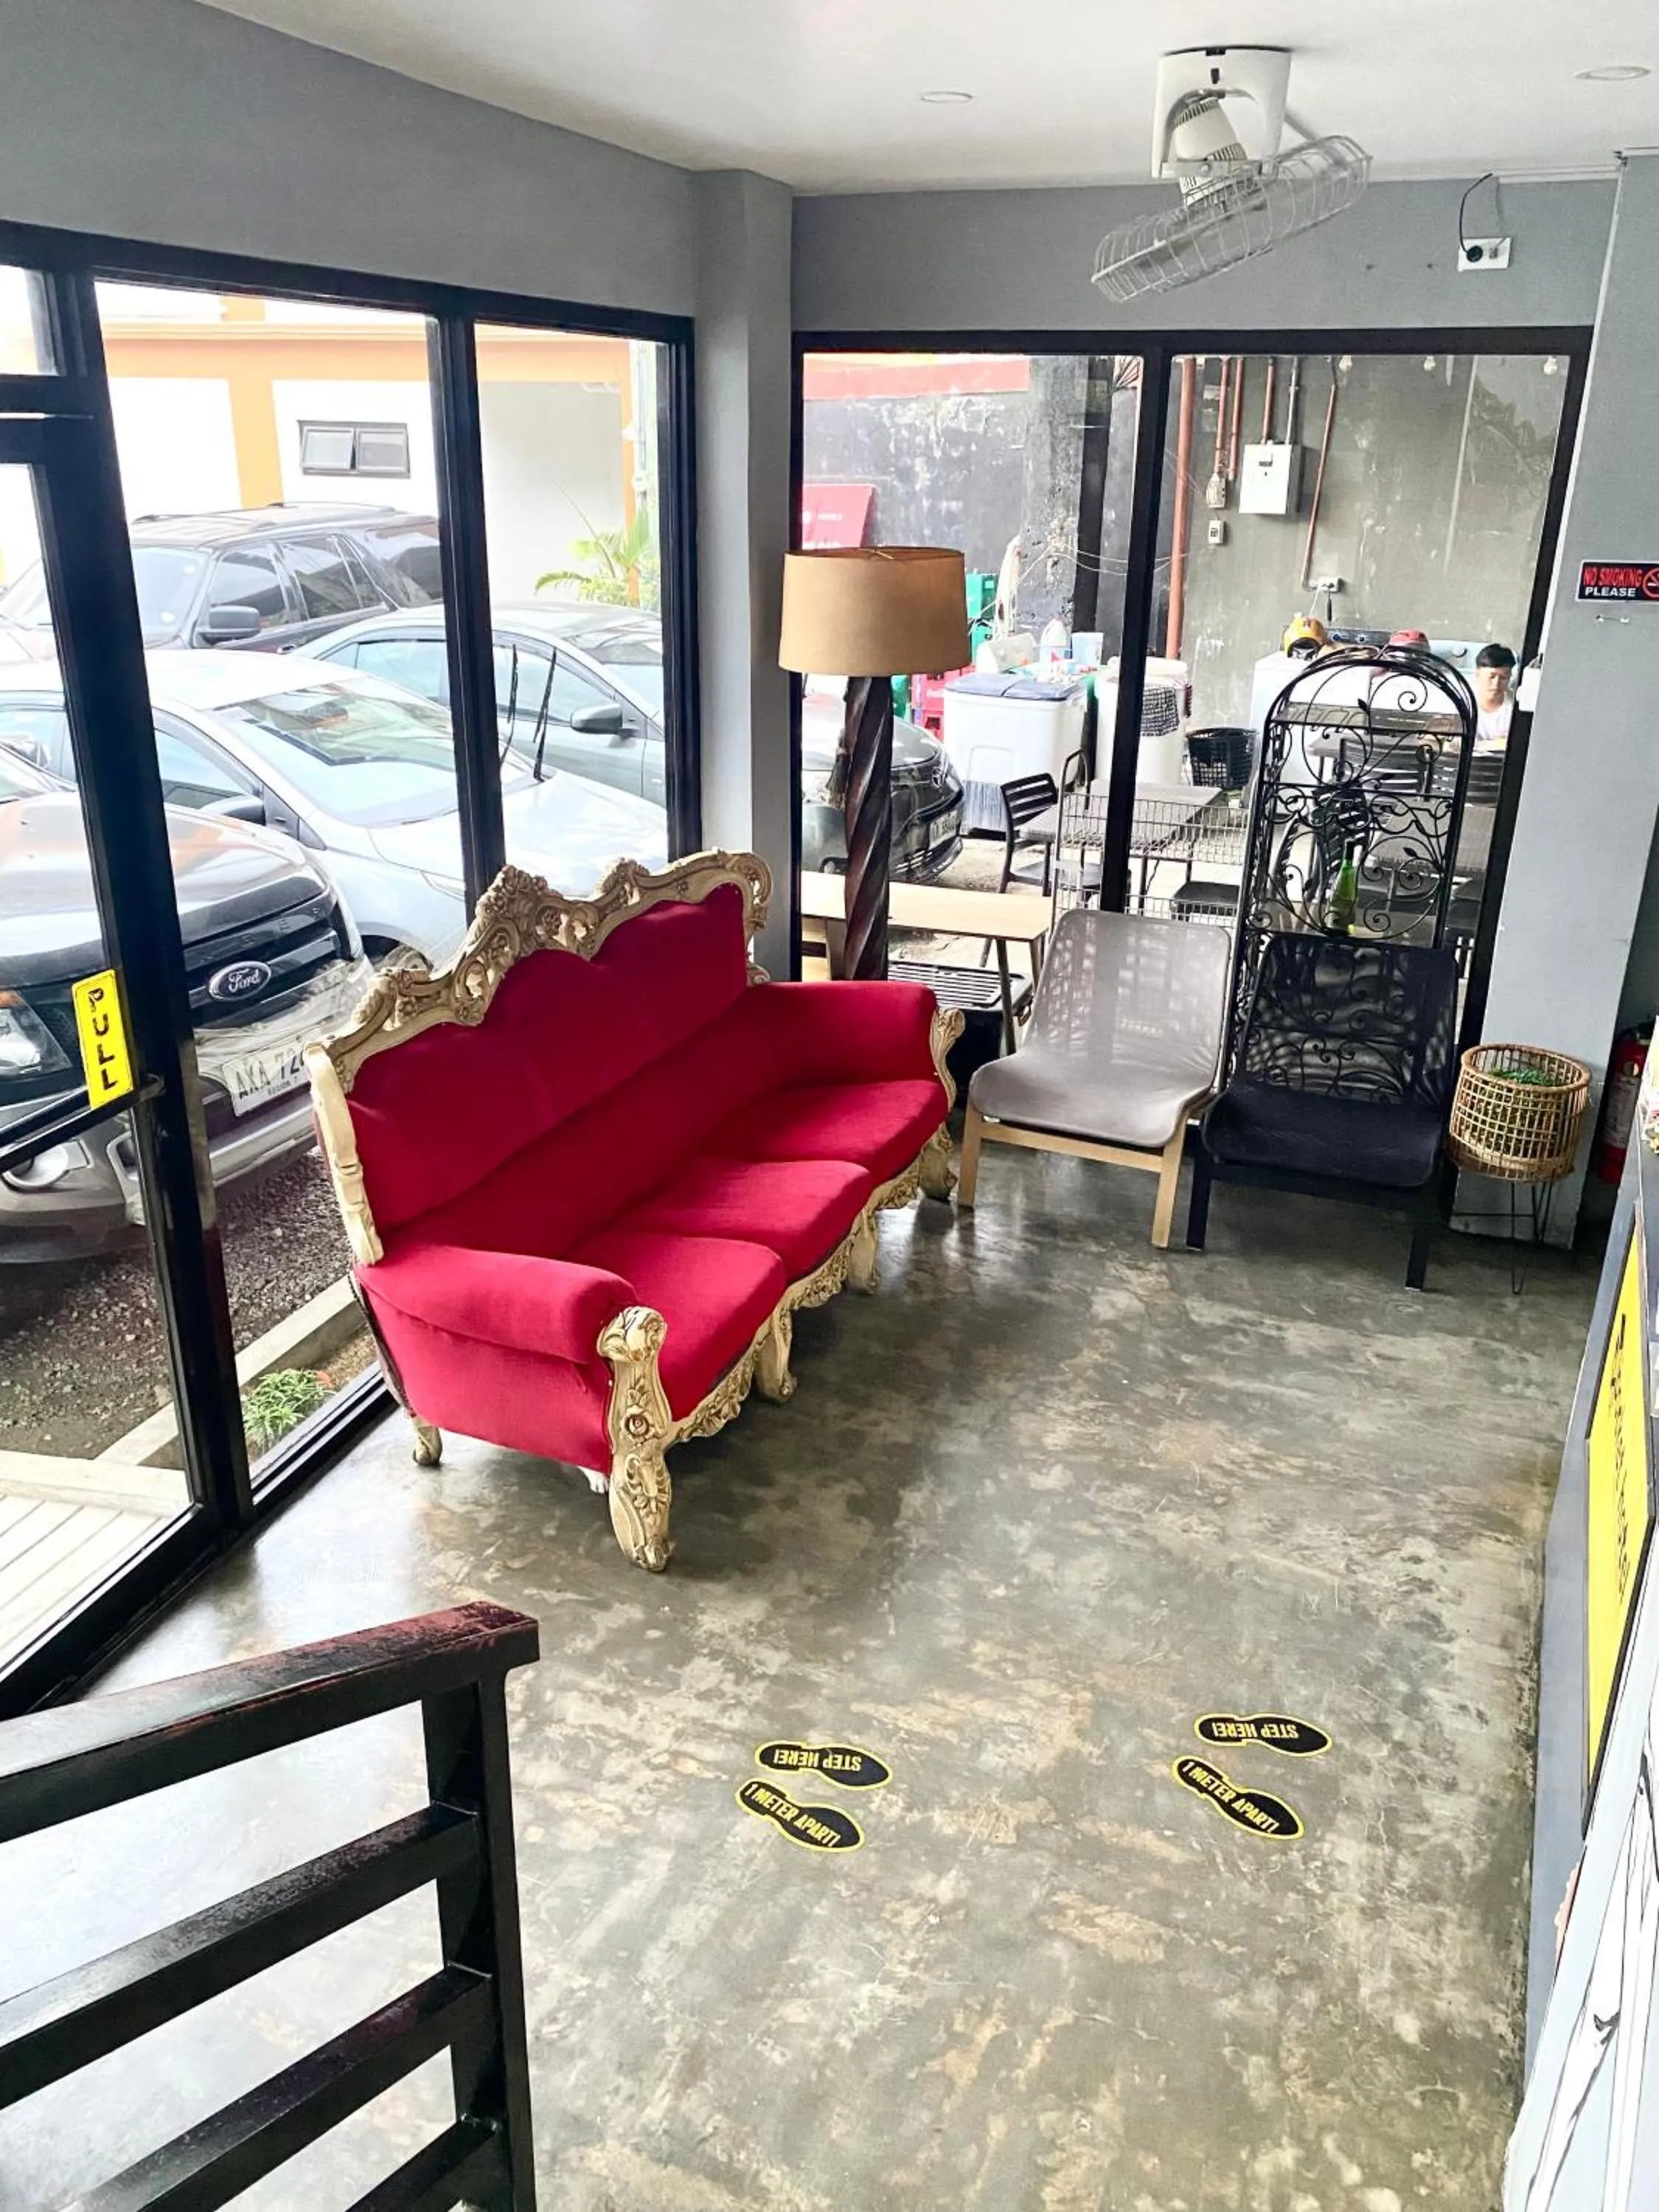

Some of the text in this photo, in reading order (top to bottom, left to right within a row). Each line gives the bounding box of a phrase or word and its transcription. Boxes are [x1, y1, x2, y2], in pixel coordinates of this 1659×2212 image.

[1585, 587, 1636, 597] PLEASE
[228, 968, 261, 993] Ford
[88, 987, 119, 1091] PULL
[1211, 1722, 1299, 1739] STEP HERE!
[773, 1749, 862, 1771] STEP HERE!
[1189, 1767, 1237, 1803] METER
[751, 1787, 800, 1822] METER
